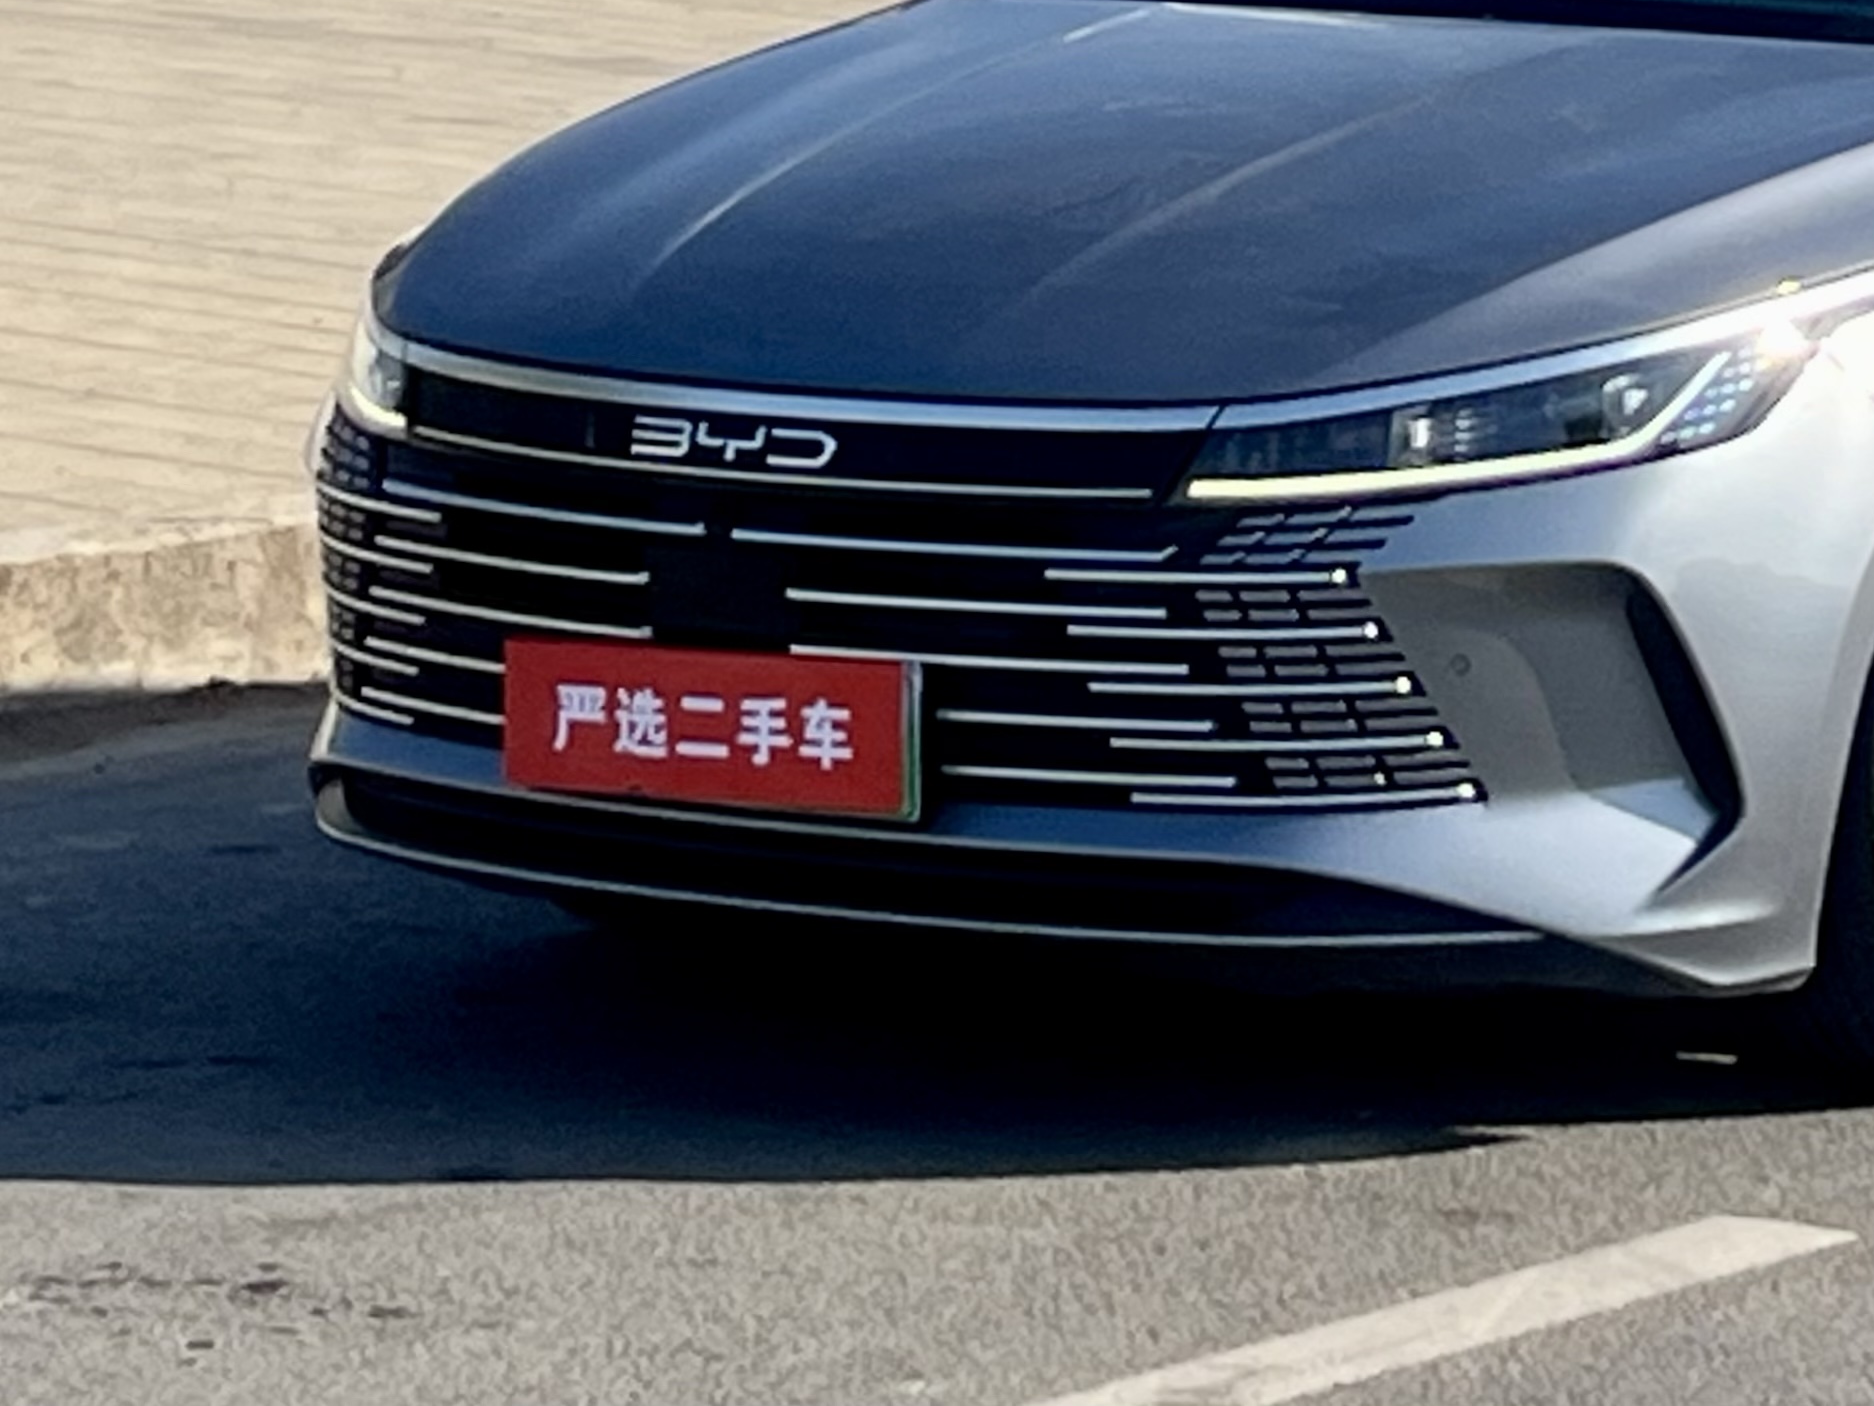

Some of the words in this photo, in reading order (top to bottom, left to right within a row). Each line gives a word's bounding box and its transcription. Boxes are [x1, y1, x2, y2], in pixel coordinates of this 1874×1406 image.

[630, 414, 838, 469] BYD
[551, 682, 854, 771] 严选二手车
